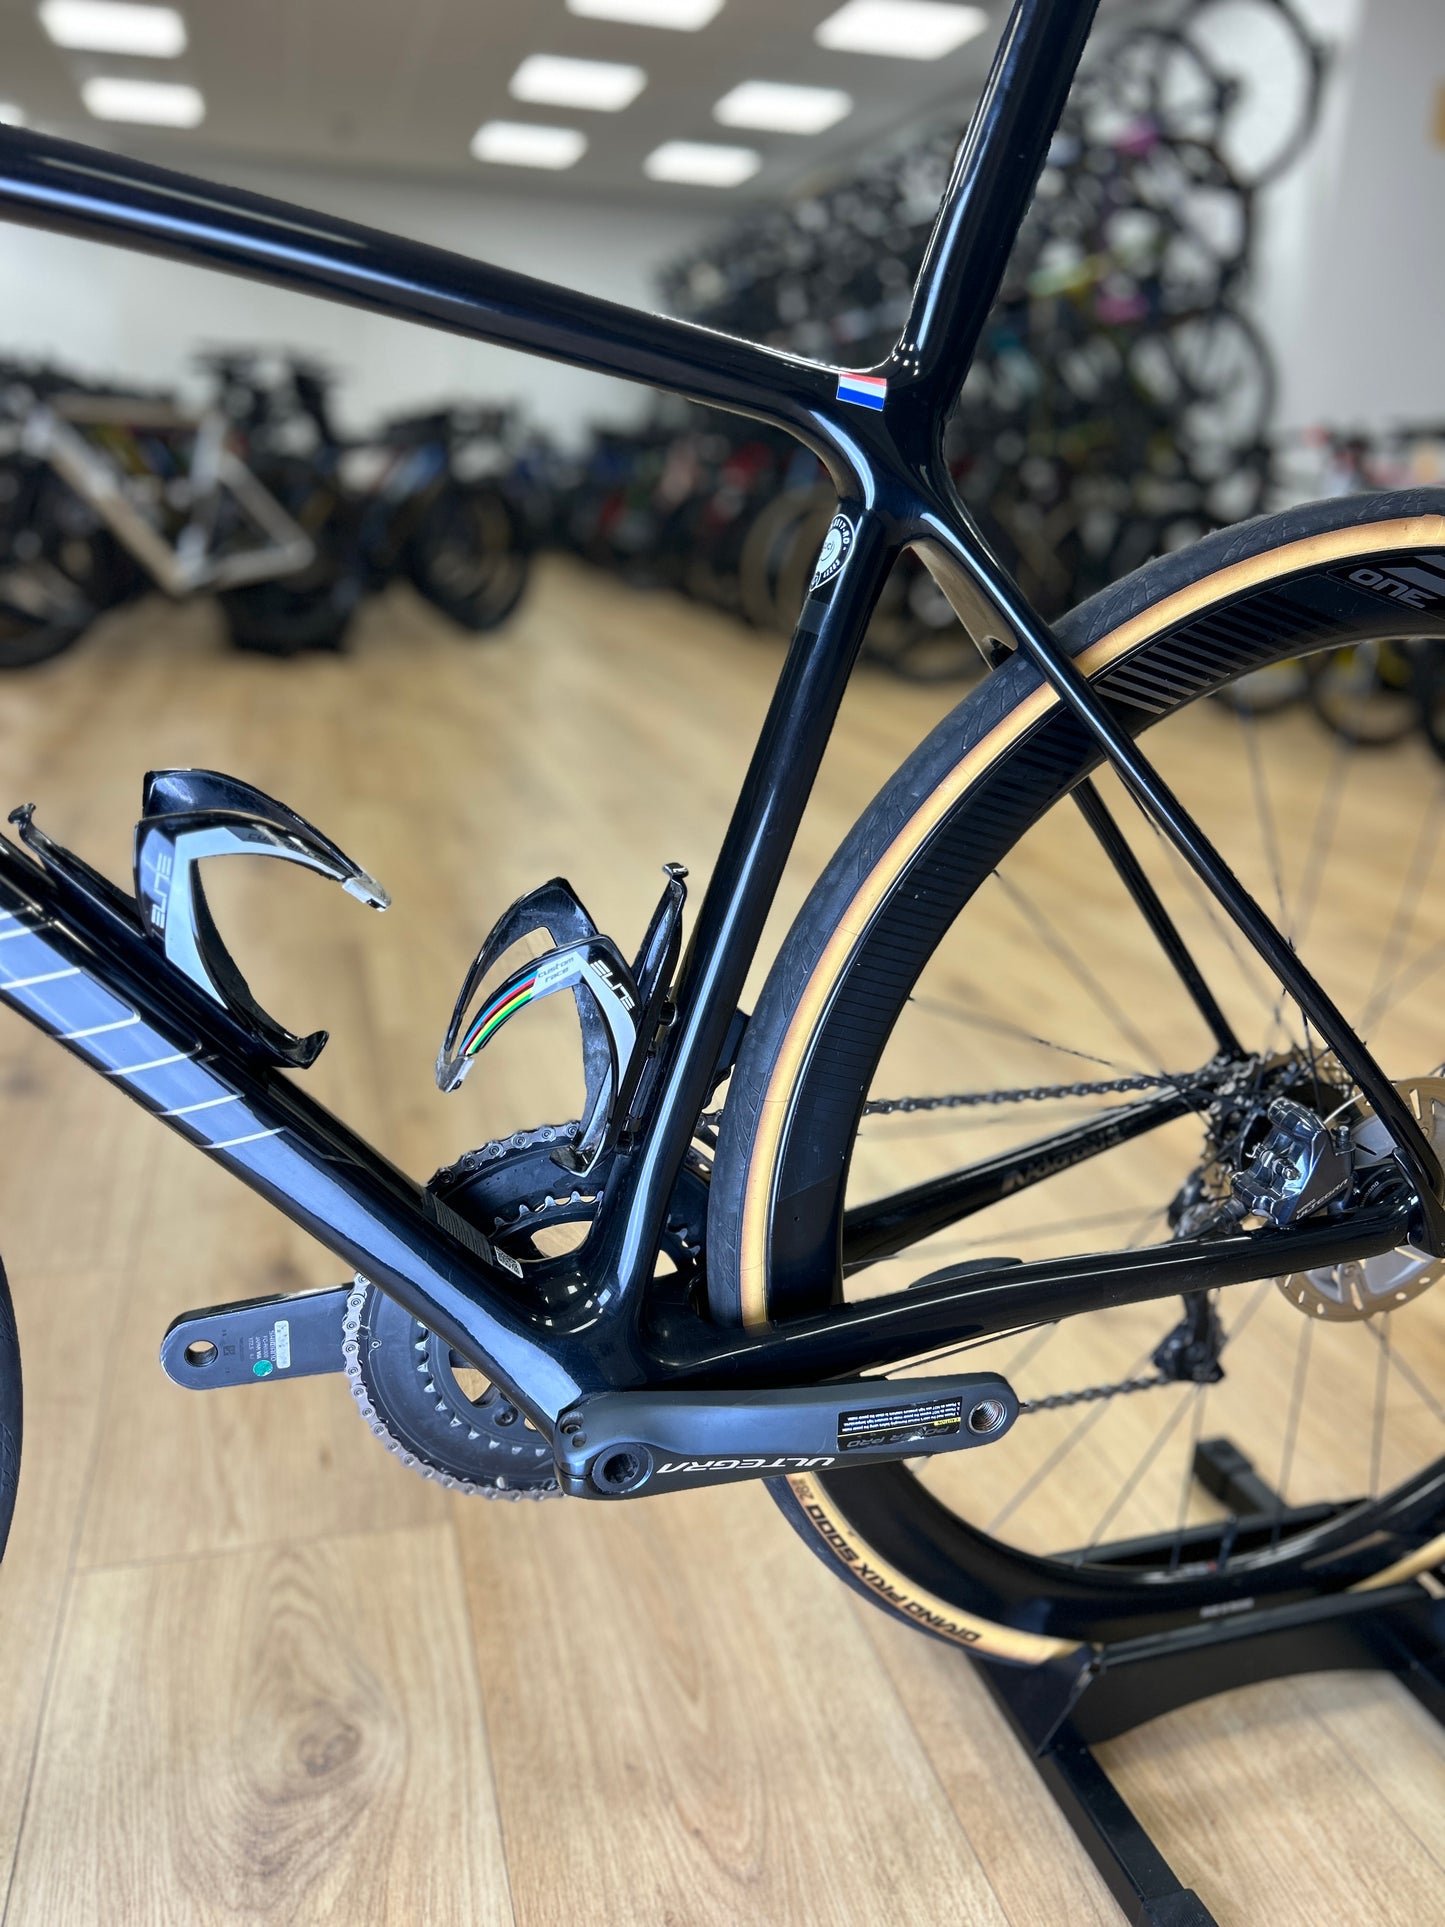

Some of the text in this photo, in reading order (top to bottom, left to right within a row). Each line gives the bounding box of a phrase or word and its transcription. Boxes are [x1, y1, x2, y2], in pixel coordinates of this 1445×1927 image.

[151, 853, 172, 929] ELITE
[590, 959, 635, 1011] ELITE
[847, 1436, 885, 1448] PRO
[656, 1457, 835, 1474] ULTEGRA
[807, 1504, 859, 1561] 5000
[853, 1562, 907, 1601] PRIX
[905, 1601, 981, 1642] GRAND
